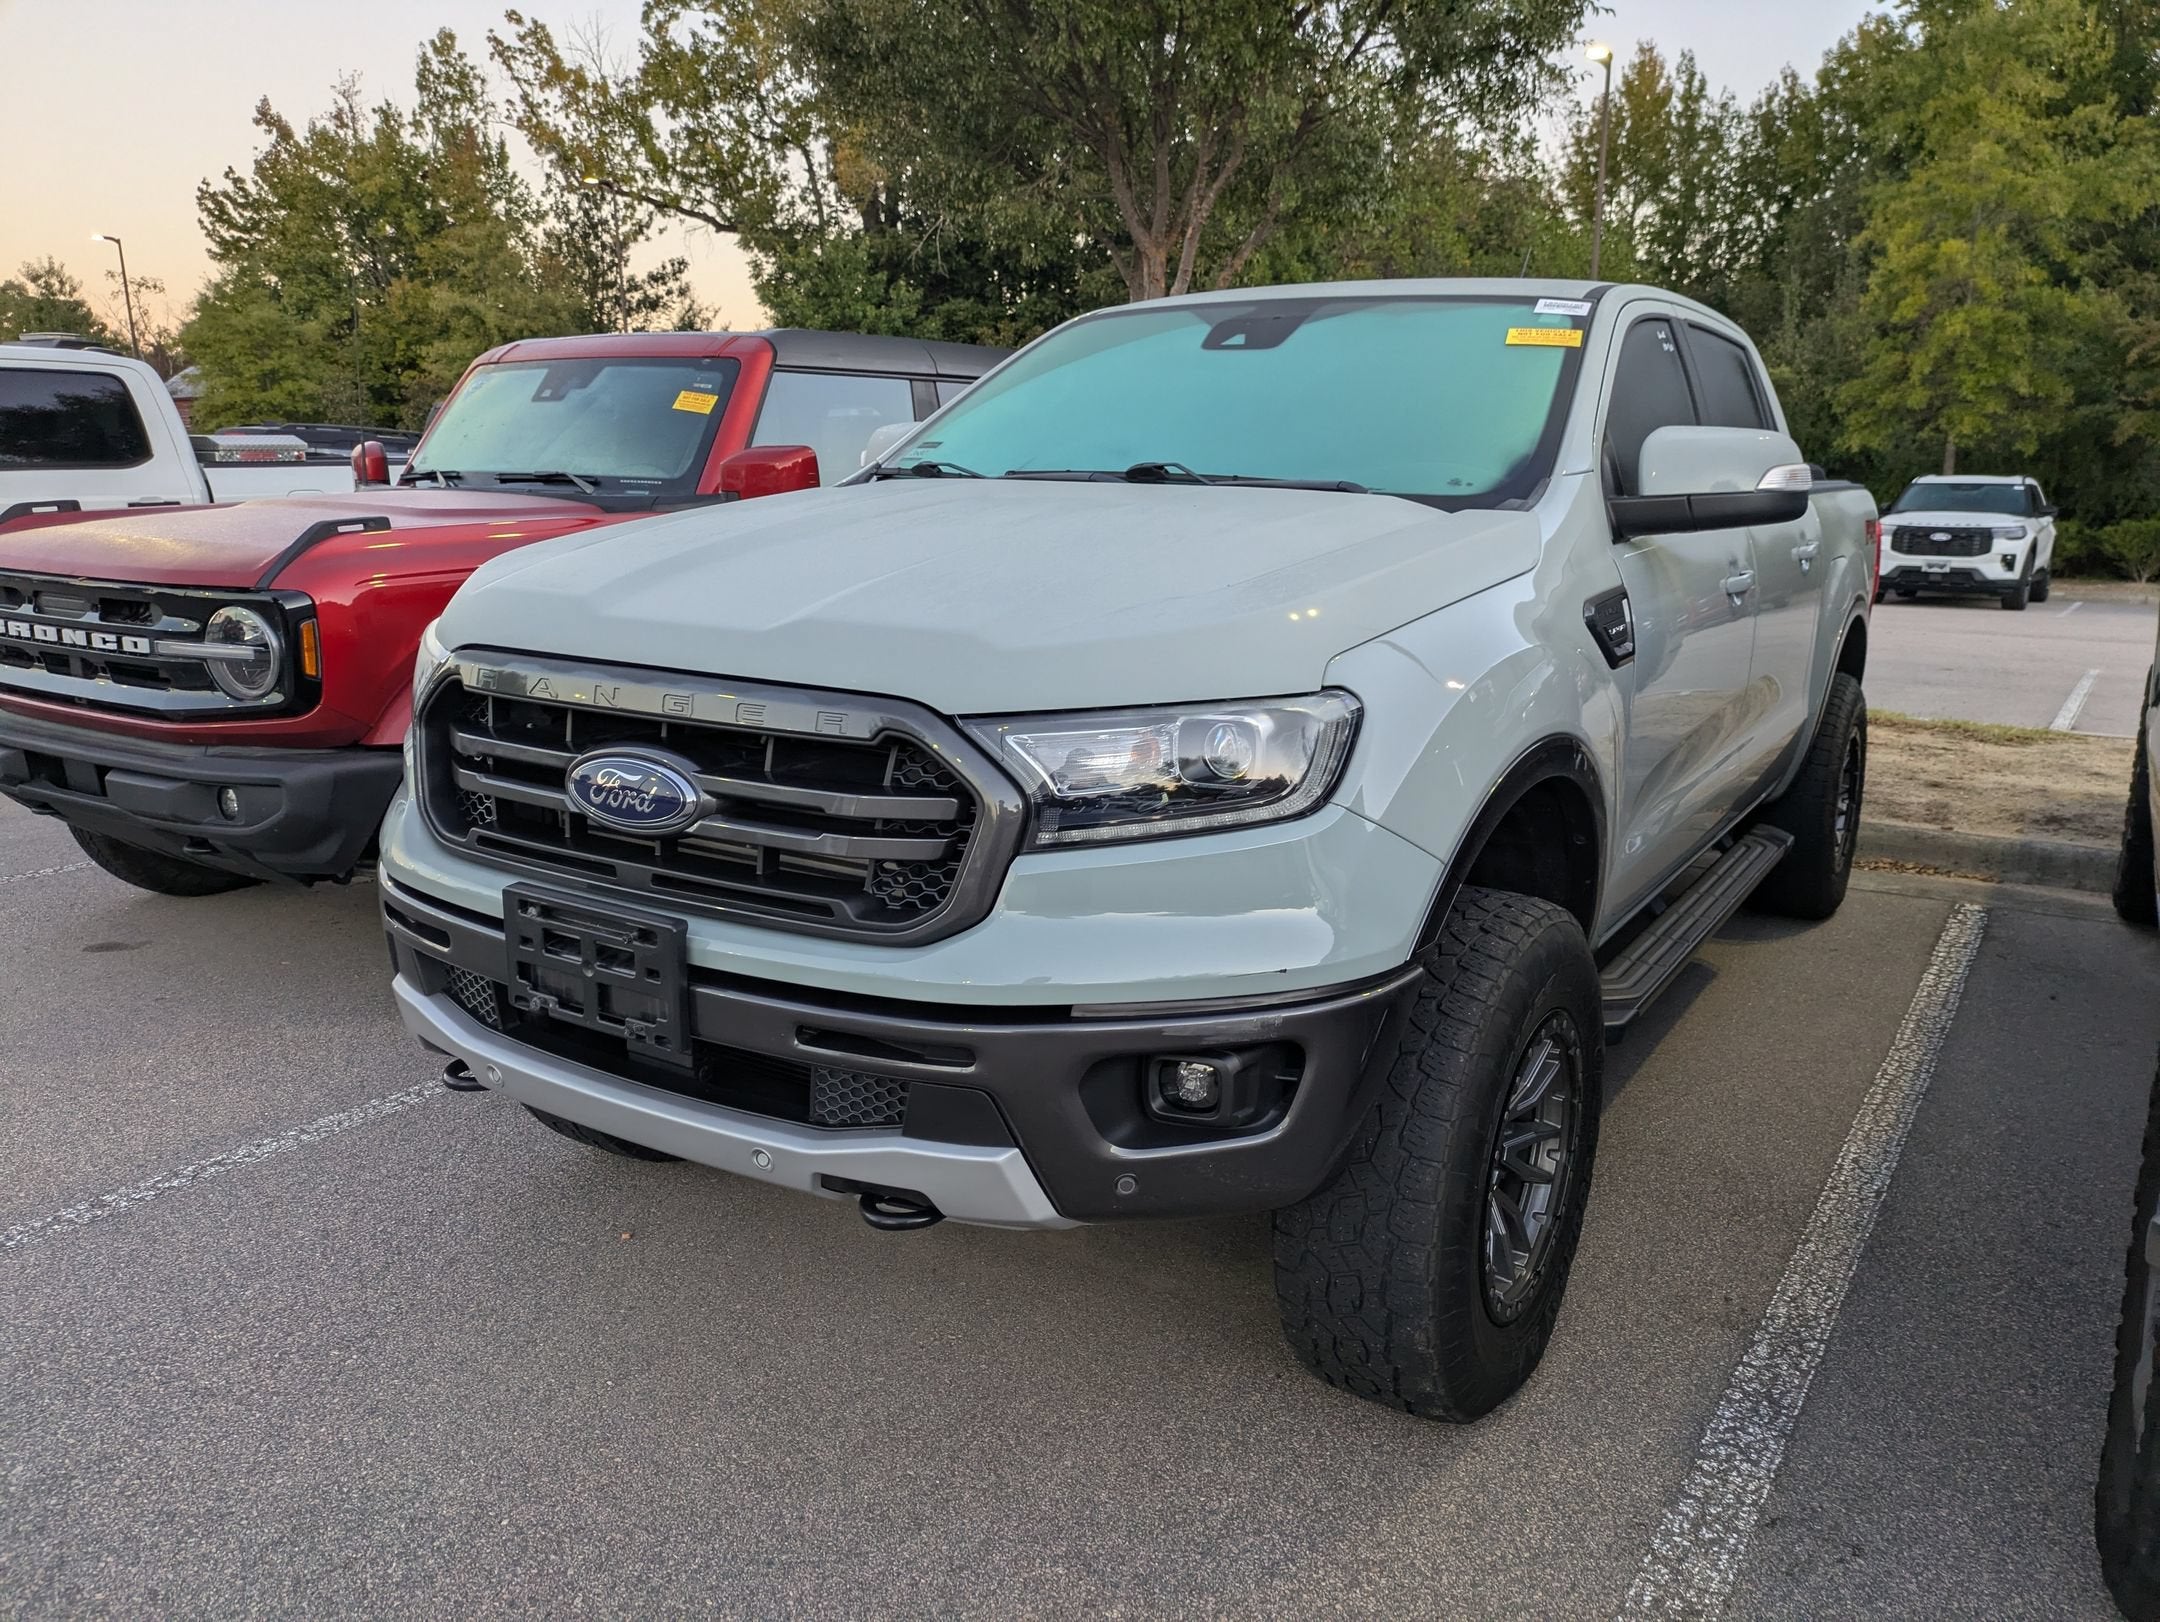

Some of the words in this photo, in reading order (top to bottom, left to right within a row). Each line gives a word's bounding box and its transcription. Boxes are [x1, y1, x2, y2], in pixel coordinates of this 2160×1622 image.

[0, 619, 150, 654] RONCO
[476, 667, 849, 735] RANGER
[589, 768, 657, 813] Ford
